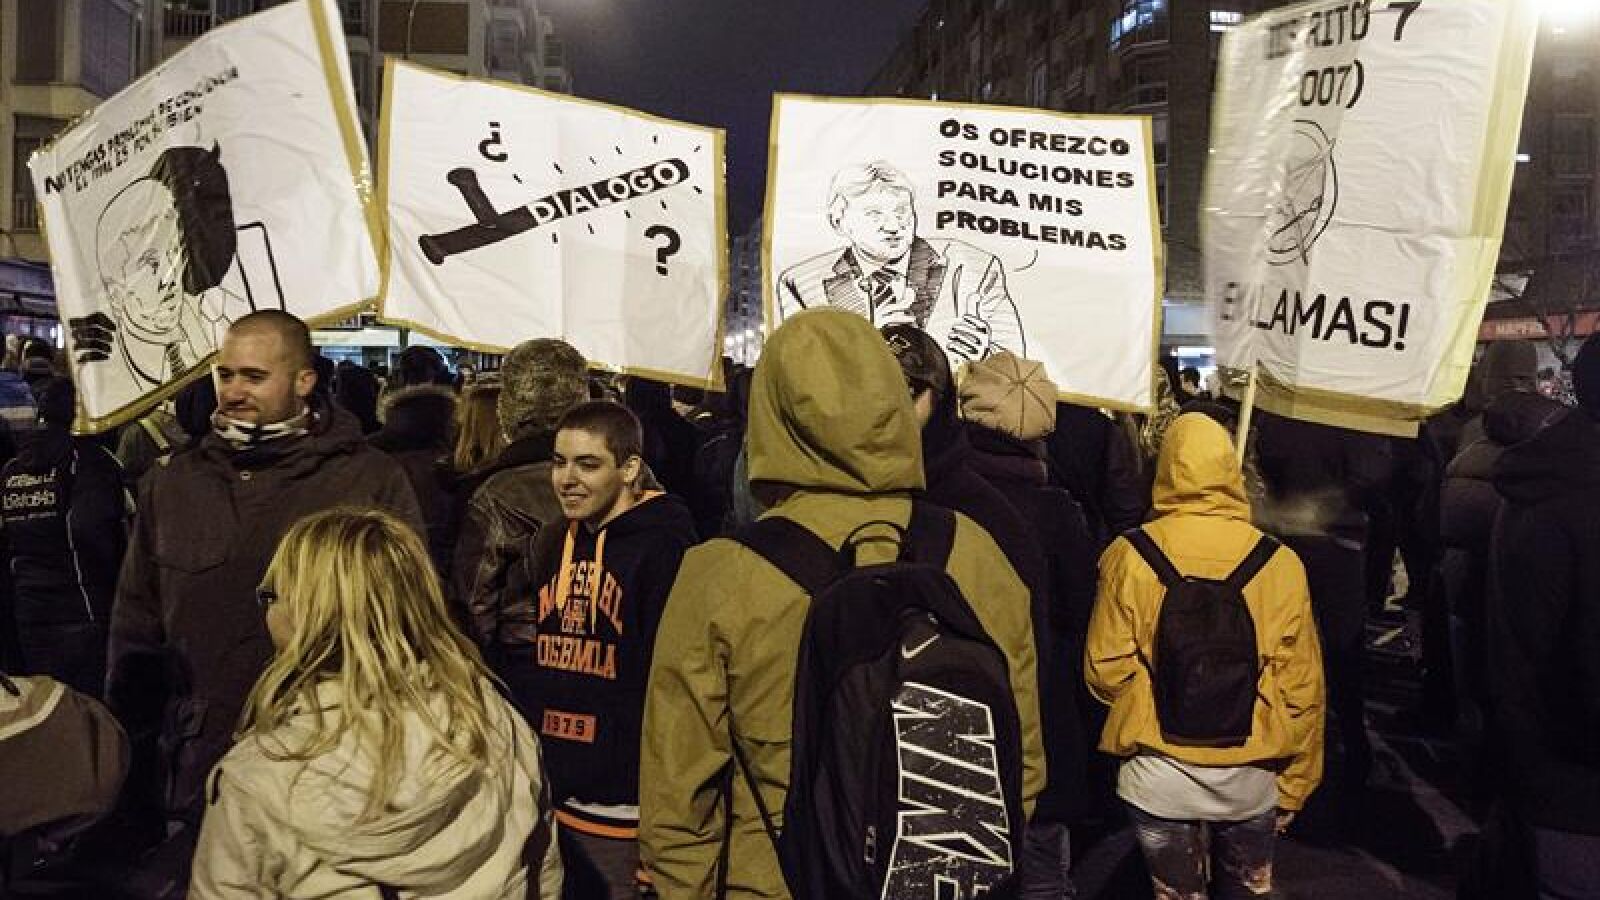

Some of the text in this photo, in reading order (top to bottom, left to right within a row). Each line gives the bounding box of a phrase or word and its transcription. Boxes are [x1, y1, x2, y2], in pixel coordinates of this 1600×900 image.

[1387, 1, 1423, 41] 7
[989, 127, 1130, 156] OFREZCO
[938, 150, 1135, 188] SOLUCIONES
[526, 161, 681, 225] DIALOGO
[937, 180, 1084, 217] PARA MIS
[935, 210, 1128, 251] PROBLEMAS
